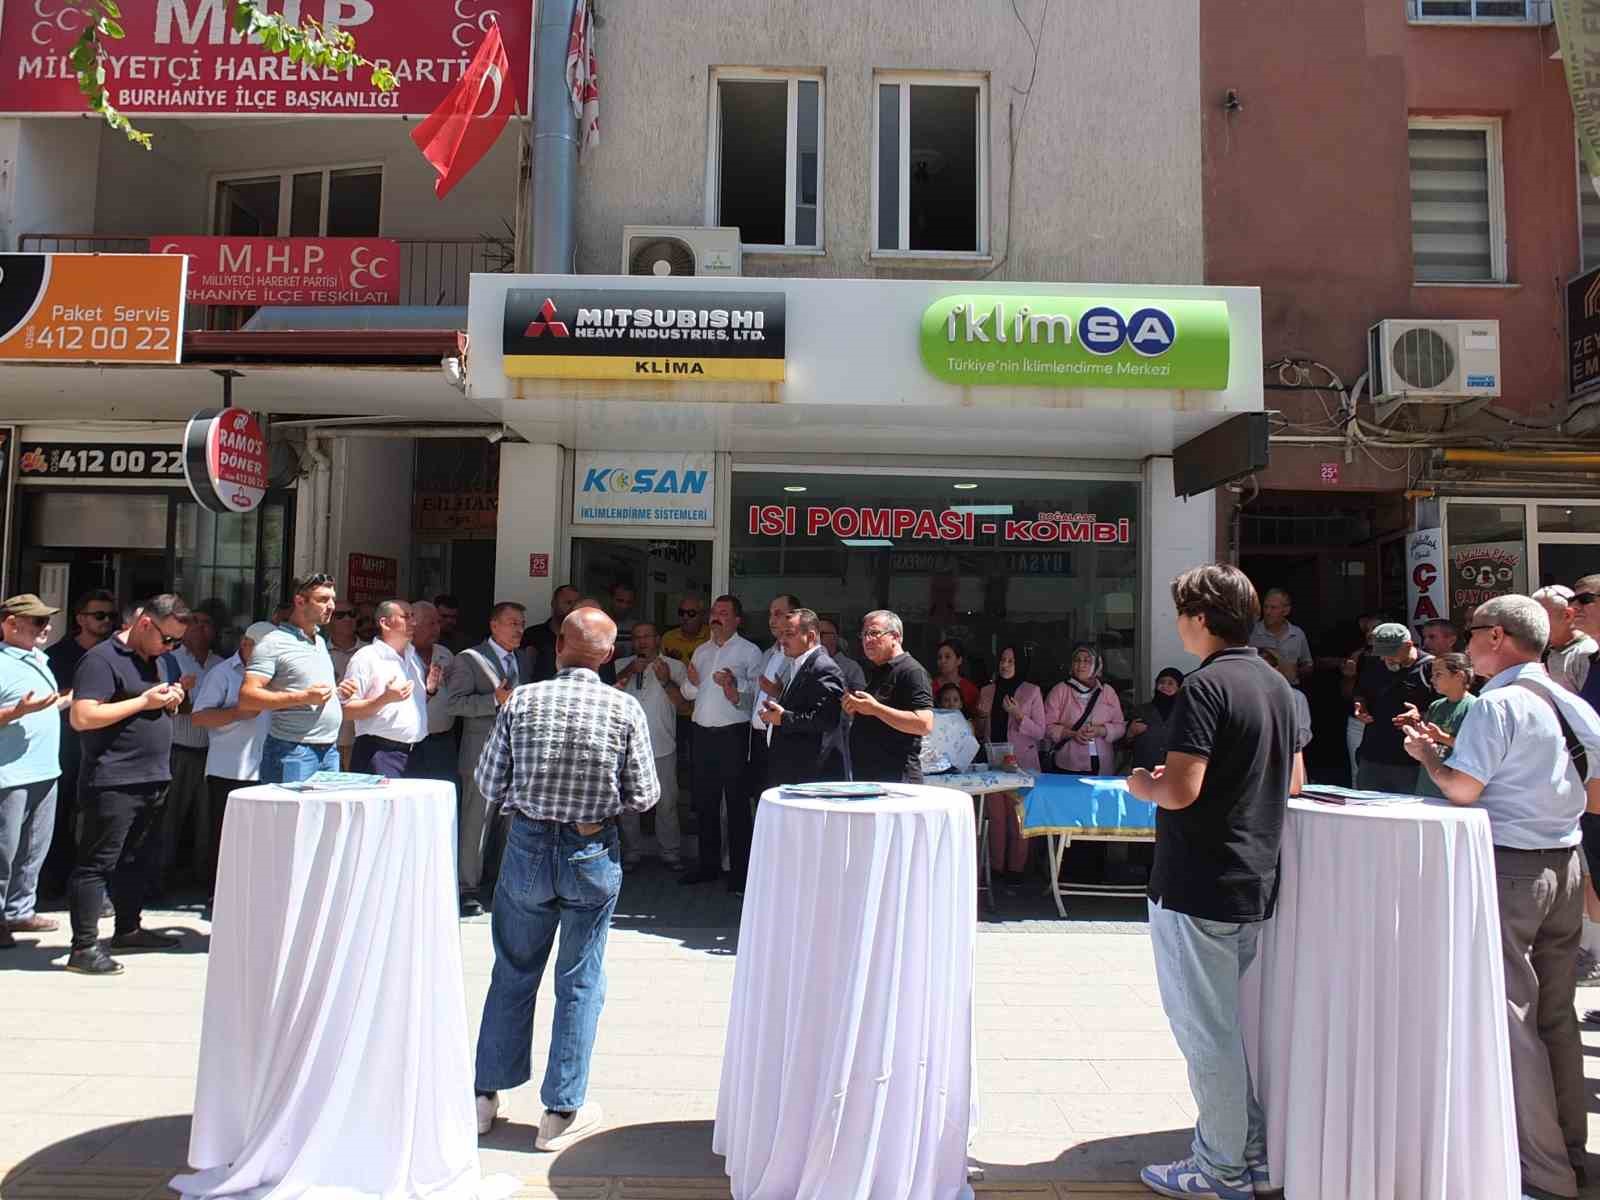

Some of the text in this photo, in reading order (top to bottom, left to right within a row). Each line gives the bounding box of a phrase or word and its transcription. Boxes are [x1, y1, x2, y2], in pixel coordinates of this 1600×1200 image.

[119, 85, 227, 106] BURHANİYE
[235, 85, 277, 110] İLÇE
[257, 275, 300, 287] HAREKET
[263, 288, 304, 304] İLÇE
[311, 289, 388, 306] TEŞKİLATI
[52, 304, 171, 322] Paket Servis
[575, 307, 765, 330] MITSUBISHI
[37, 325, 84, 350] 412
[91, 326, 128, 351] 00
[135, 326, 171, 351] 22
[575, 326, 625, 340] HEAVY
[733, 330, 765, 342] LTD.
[634, 357, 705, 375] KLİMA
[946, 357, 1171, 377] Türkiye'nin İklimlendirme Merkezi
[220, 429, 263, 456] RAMO'S
[59, 449, 105, 473] 412
[110, 450, 145, 473] 00
[151, 450, 184, 474] 22
[220, 451, 263, 476] DÖNER
[749, 504, 796, 537] ISI
[807, 505, 975, 541] POMPASI
[1005, 518, 1129, 544] KOMBİ
